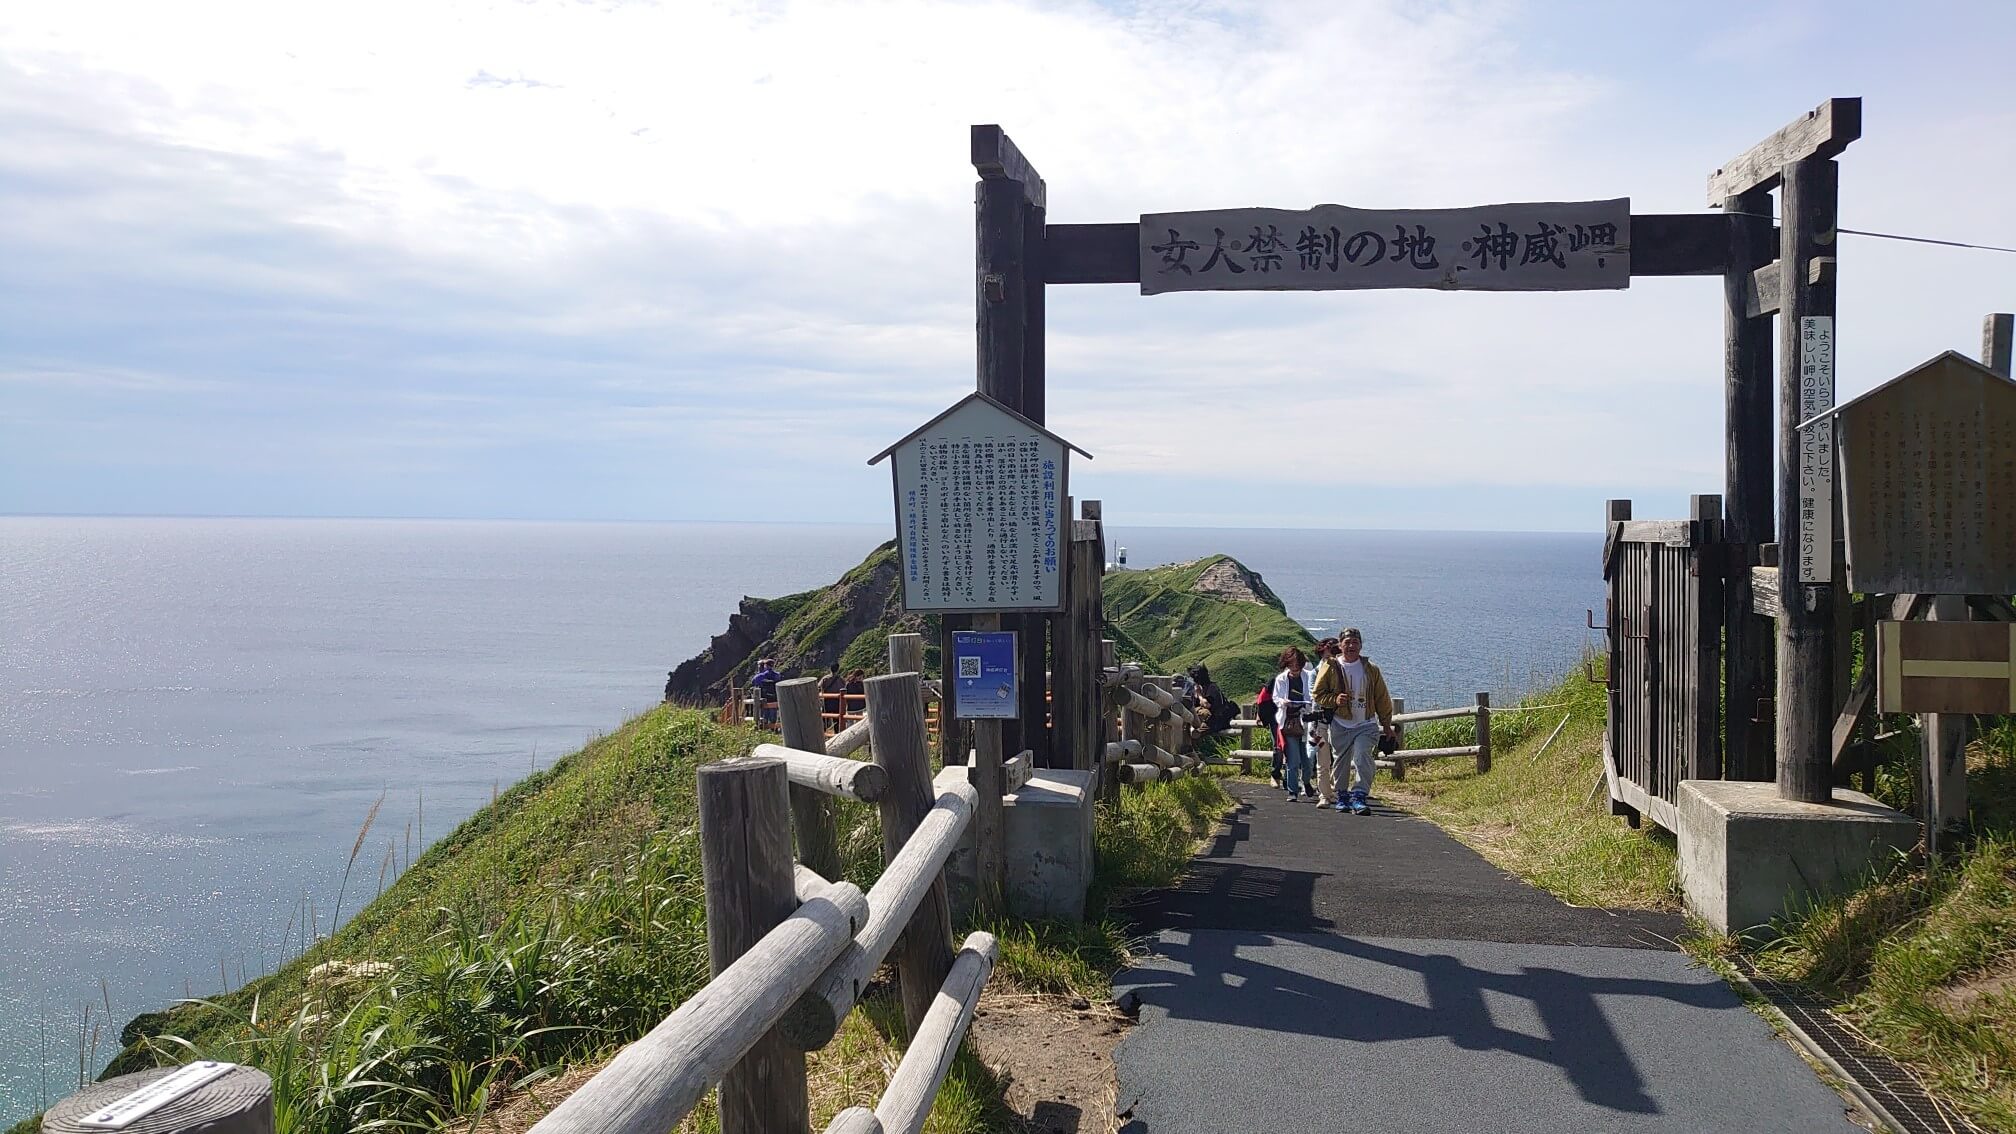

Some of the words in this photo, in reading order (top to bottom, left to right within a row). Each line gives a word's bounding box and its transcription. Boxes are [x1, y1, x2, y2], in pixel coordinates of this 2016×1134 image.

[1043, 460, 1057, 573] 施設利用に当たってのお願い
